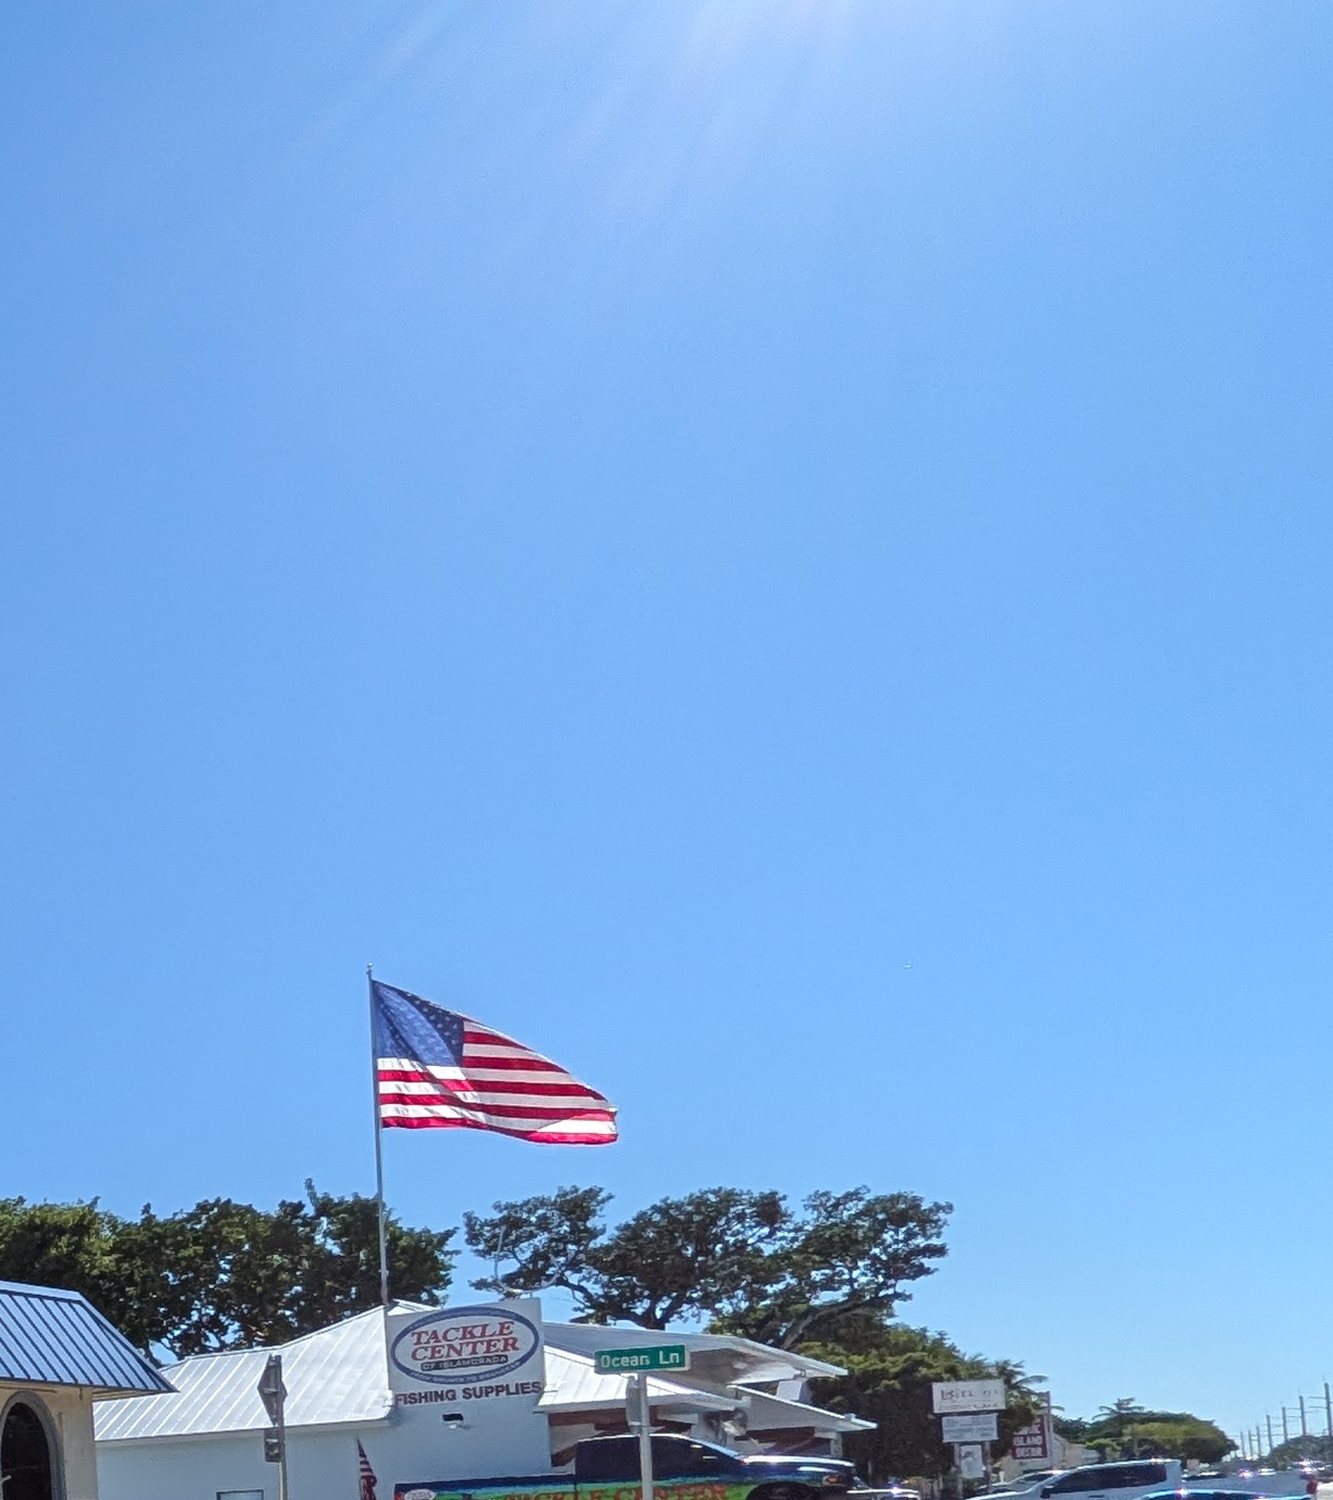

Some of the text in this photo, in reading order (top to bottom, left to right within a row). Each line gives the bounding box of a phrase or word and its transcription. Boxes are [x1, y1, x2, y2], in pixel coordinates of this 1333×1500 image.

[411, 1321, 515, 1346] TACKLE
[411, 1336, 520, 1361] CENTER
[601, 1350, 680, 1368] Ocean Ln
[439, 1355, 508, 1369] ISLAMORADA
[395, 1381, 541, 1405] FISHING SUPPLIES
